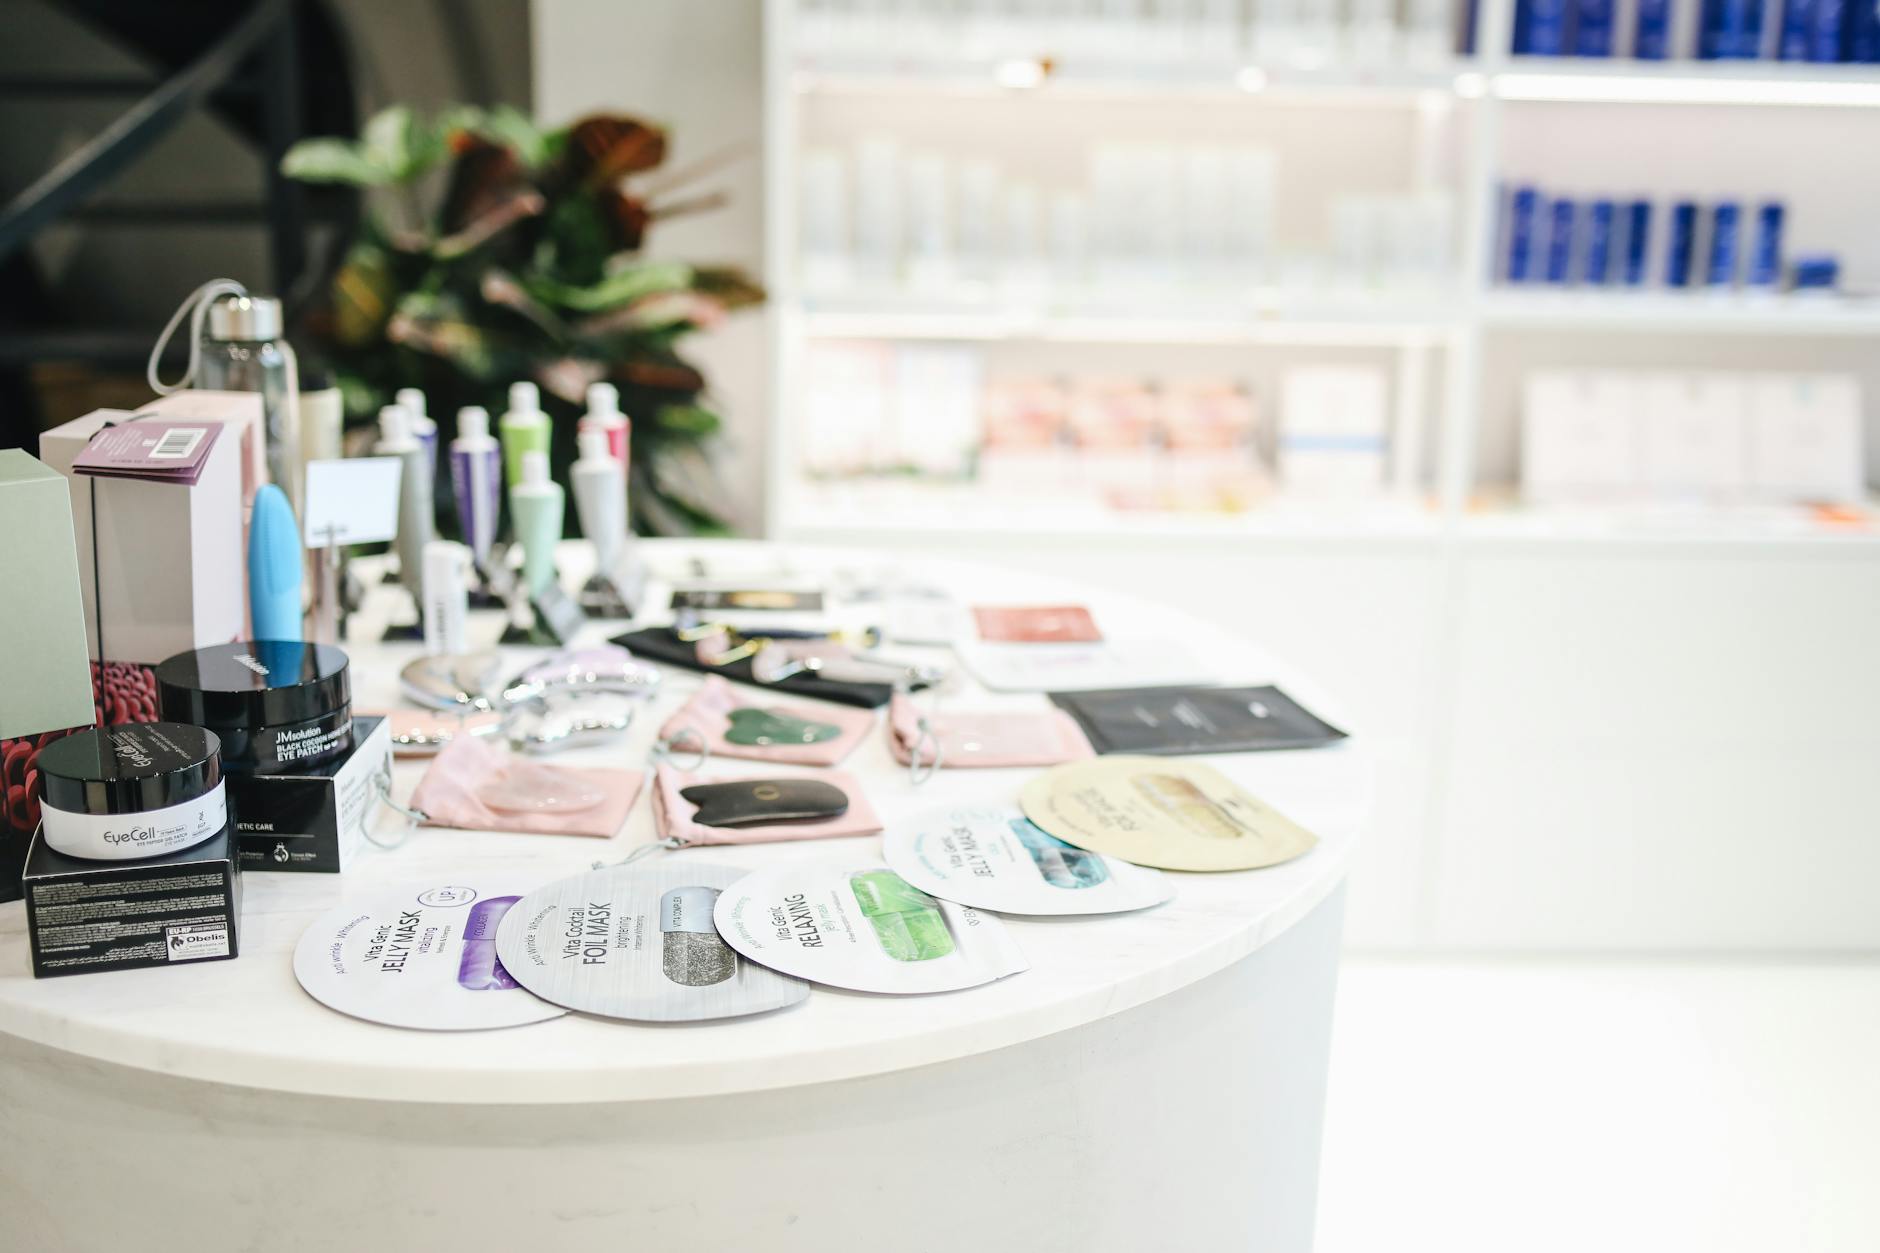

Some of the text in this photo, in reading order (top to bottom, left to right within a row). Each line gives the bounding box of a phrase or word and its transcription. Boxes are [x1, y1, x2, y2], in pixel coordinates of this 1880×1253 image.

[276, 742, 301, 753] BLACK
[277, 744, 323, 762] EYE PATCH
[103, 827, 155, 846] EyeCell
[237, 823, 274, 831] ETIC CARE
[562, 907, 585, 959] Vita Cocktail
[582, 902, 612, 965] FOIL MASK
[614, 916, 631, 949] brightening
[769, 906, 793, 941] Vita Genic
[784, 893, 824, 948] RELAXING
[186, 933, 225, 943] Obelis
[362, 925, 392, 962] Vita Genic
[381, 909, 423, 973] JELLY MASK
